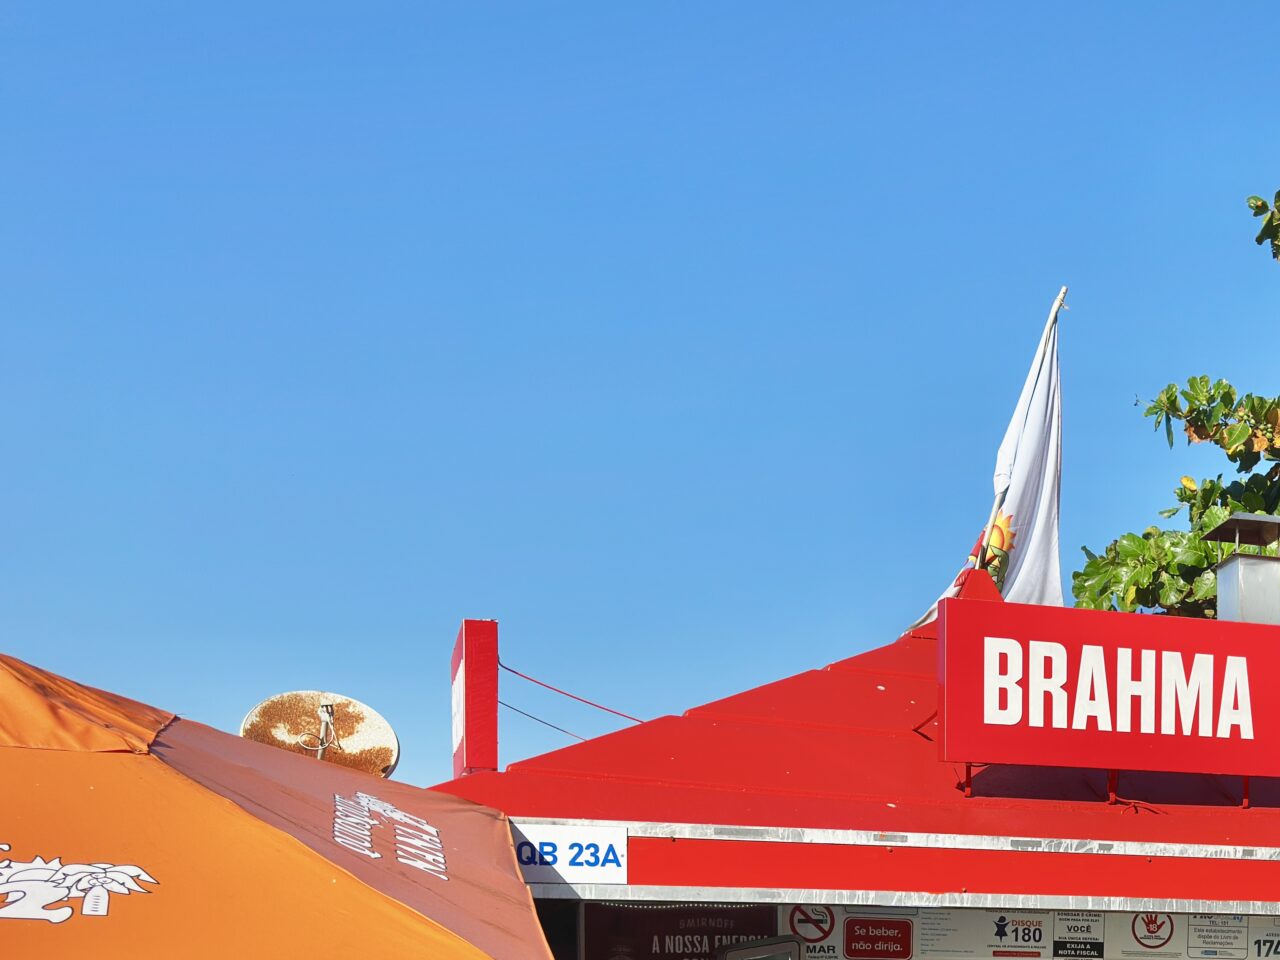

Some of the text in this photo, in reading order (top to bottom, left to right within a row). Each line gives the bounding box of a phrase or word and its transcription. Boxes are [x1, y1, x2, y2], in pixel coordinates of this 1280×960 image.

[983, 636, 1254, 740] BRAHMA
[518, 842, 621, 868] QB 23A
[1011, 919, 1043, 927] DISQUE
[854, 925, 902, 938] Se beber,
[1011, 927, 1043, 943] 180
[652, 935, 660, 953] A
[665, 935, 709, 953] NOSSA
[806, 945, 836, 954] MAR
[852, 941, 903, 952] não dirija.
